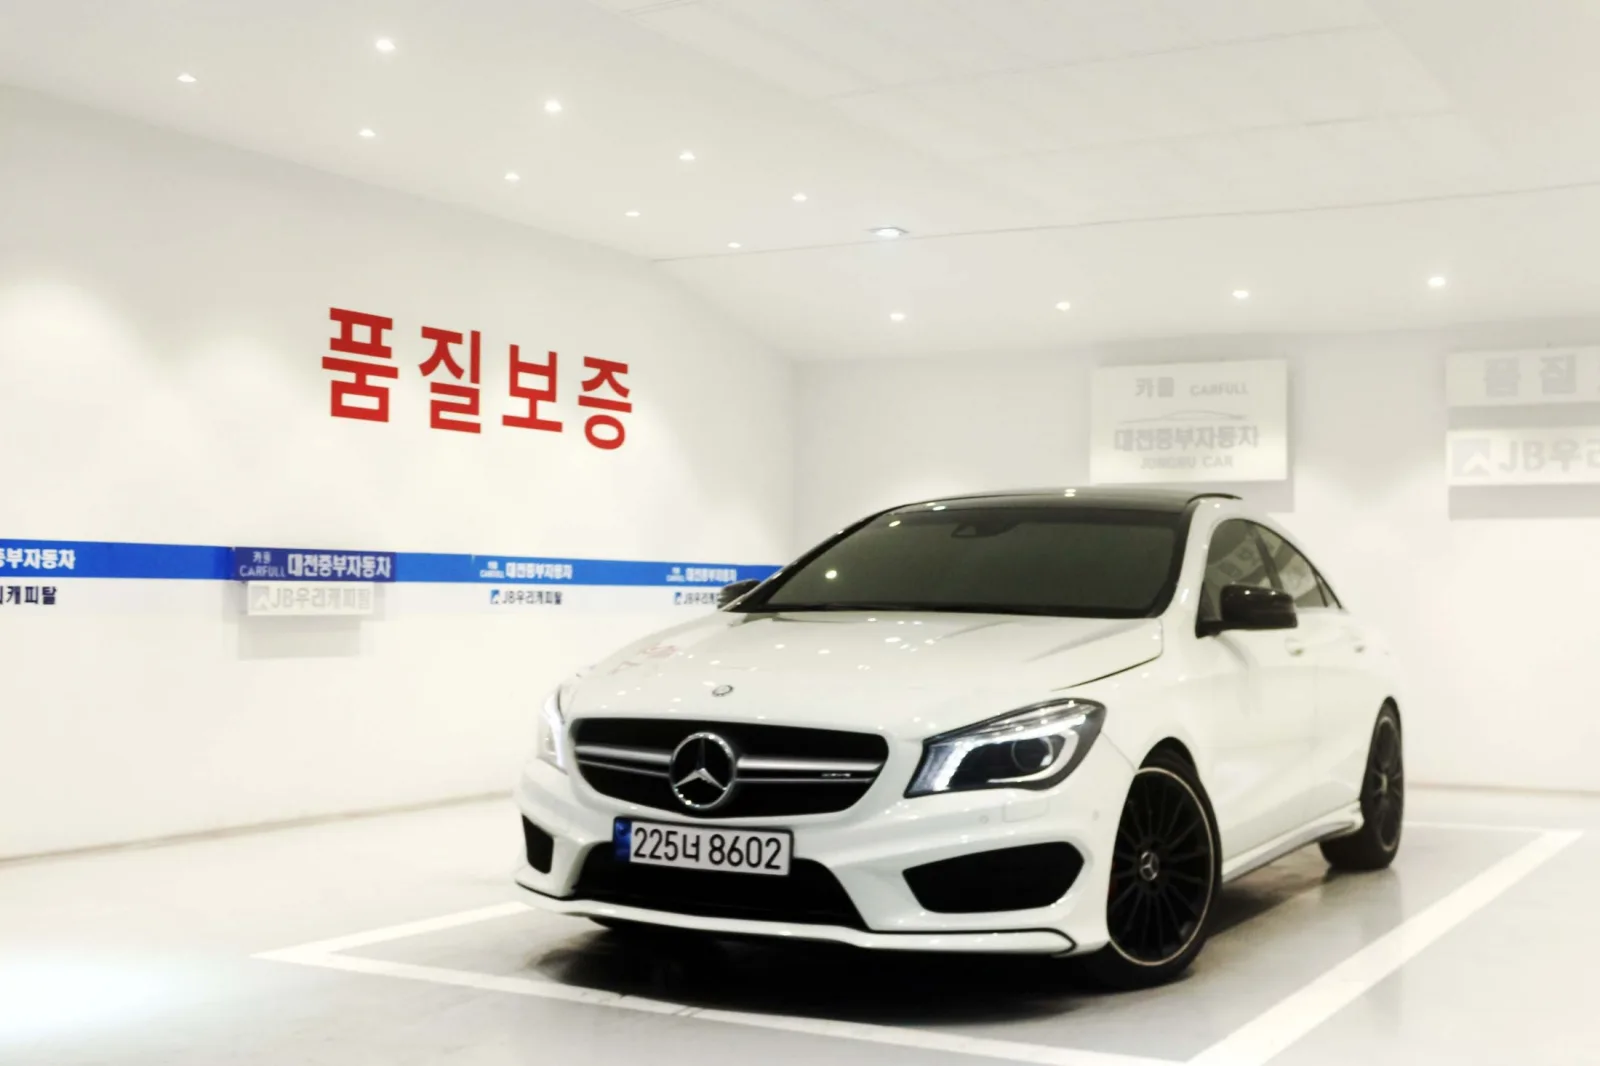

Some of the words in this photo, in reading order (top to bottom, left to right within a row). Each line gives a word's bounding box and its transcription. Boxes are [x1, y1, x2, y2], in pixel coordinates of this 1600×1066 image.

[322, 307, 632, 450] 품질보증
[287, 553, 392, 579] 대전중부자동차
[0, 585, 57, 605] 캐피탈
[633, 827, 701, 863] 225너
[708, 833, 782, 870] 8602
